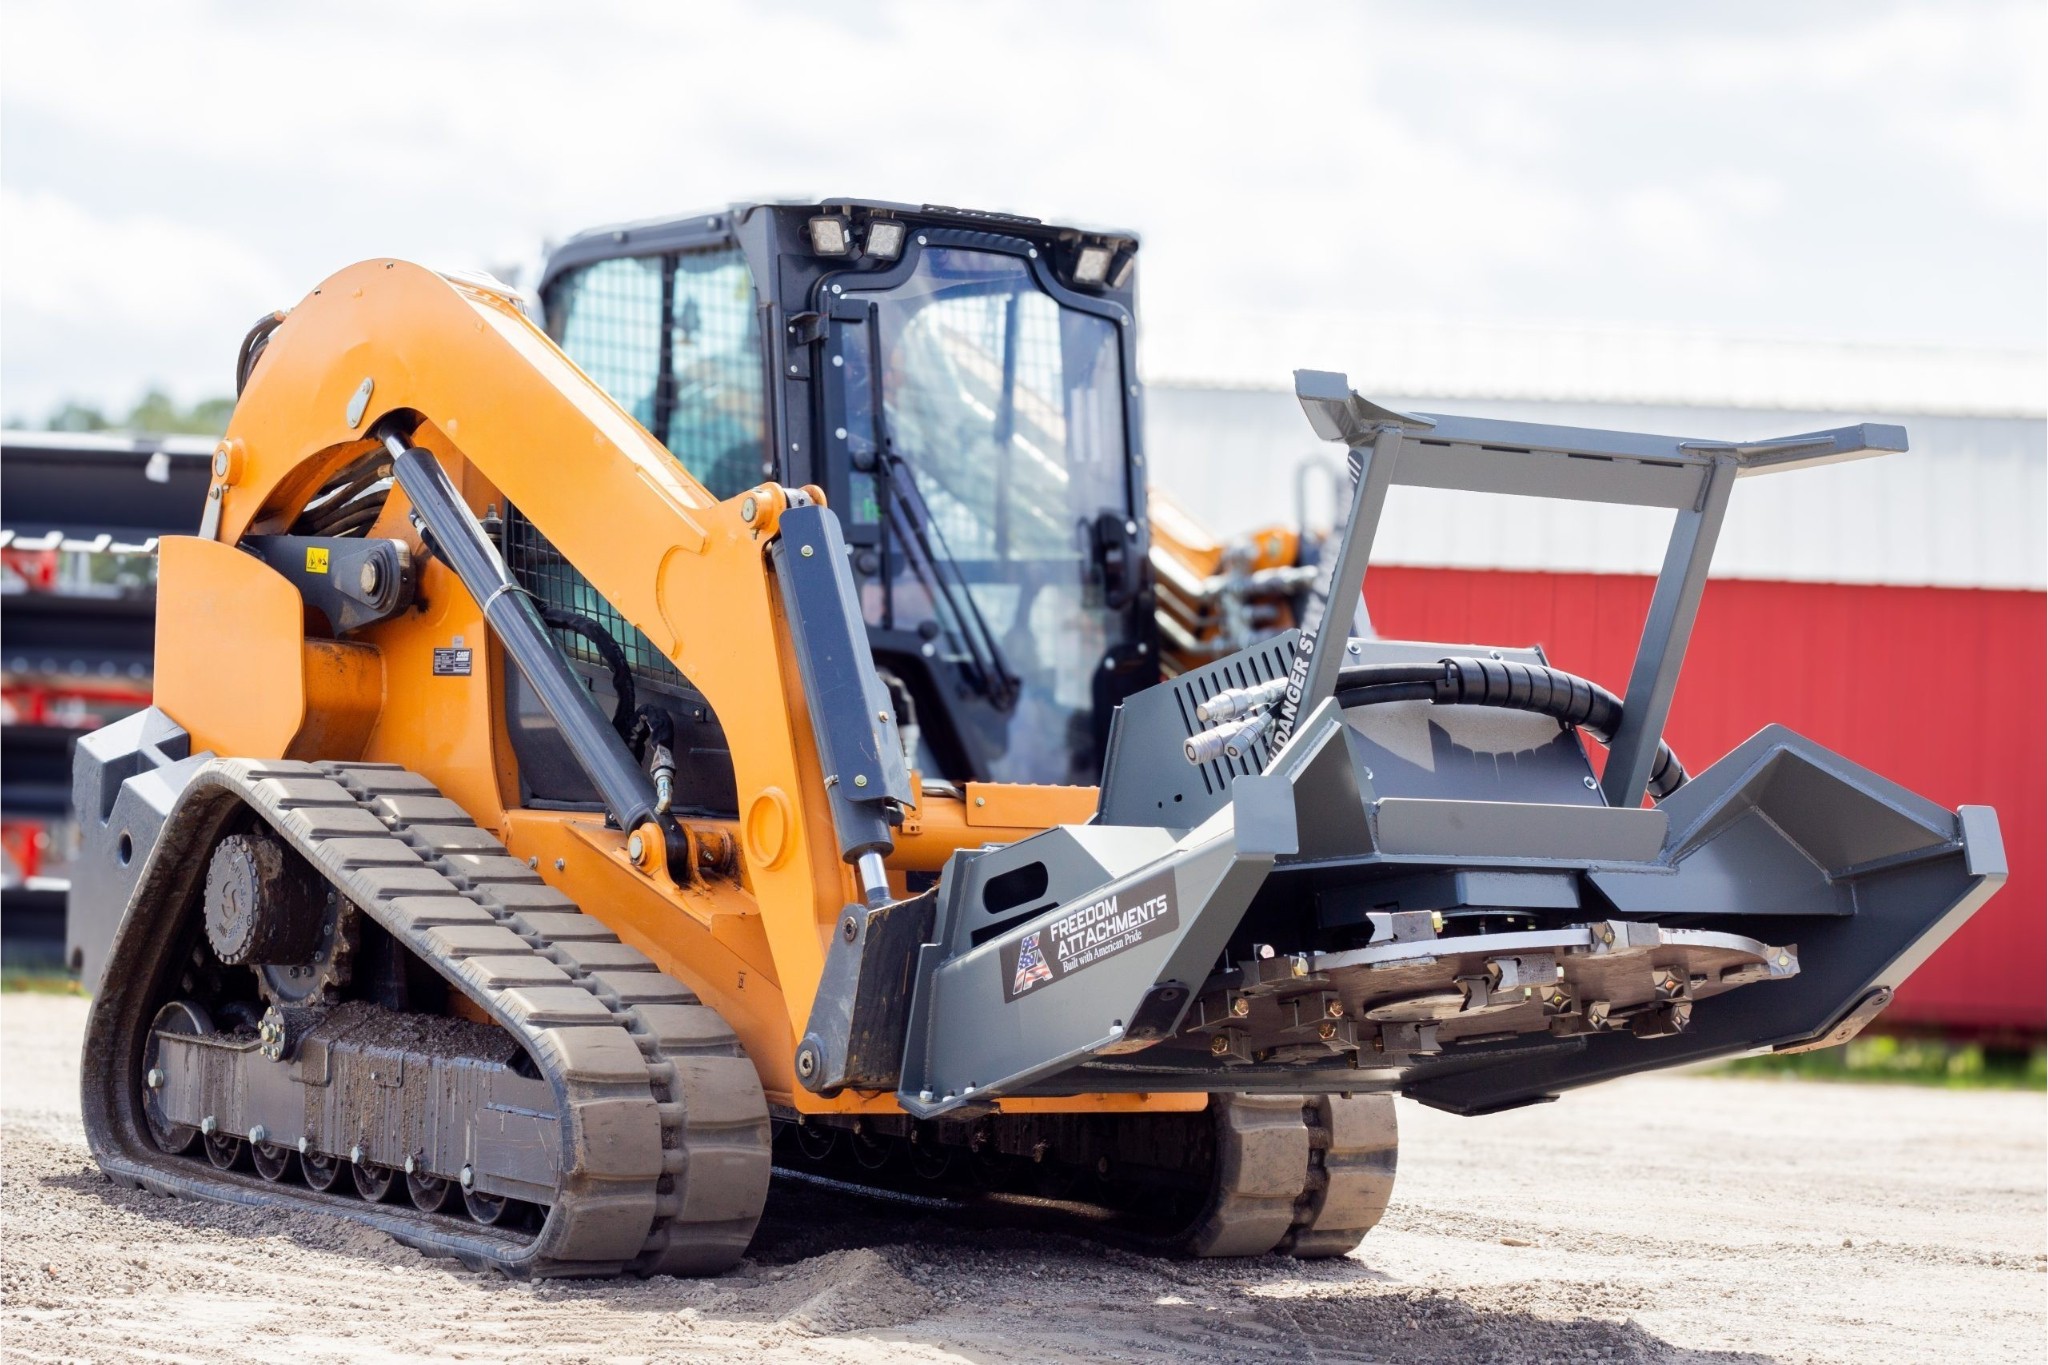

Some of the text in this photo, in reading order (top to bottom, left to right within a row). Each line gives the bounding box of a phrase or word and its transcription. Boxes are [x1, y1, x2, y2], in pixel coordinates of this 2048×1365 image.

[1274, 657, 1310, 748] DANGER
[1050, 896, 1118, 942] FREEDOM
[1057, 894, 1168, 960] ATTACHMENTS
[1063, 929, 1142, 973] Built with American Pride
